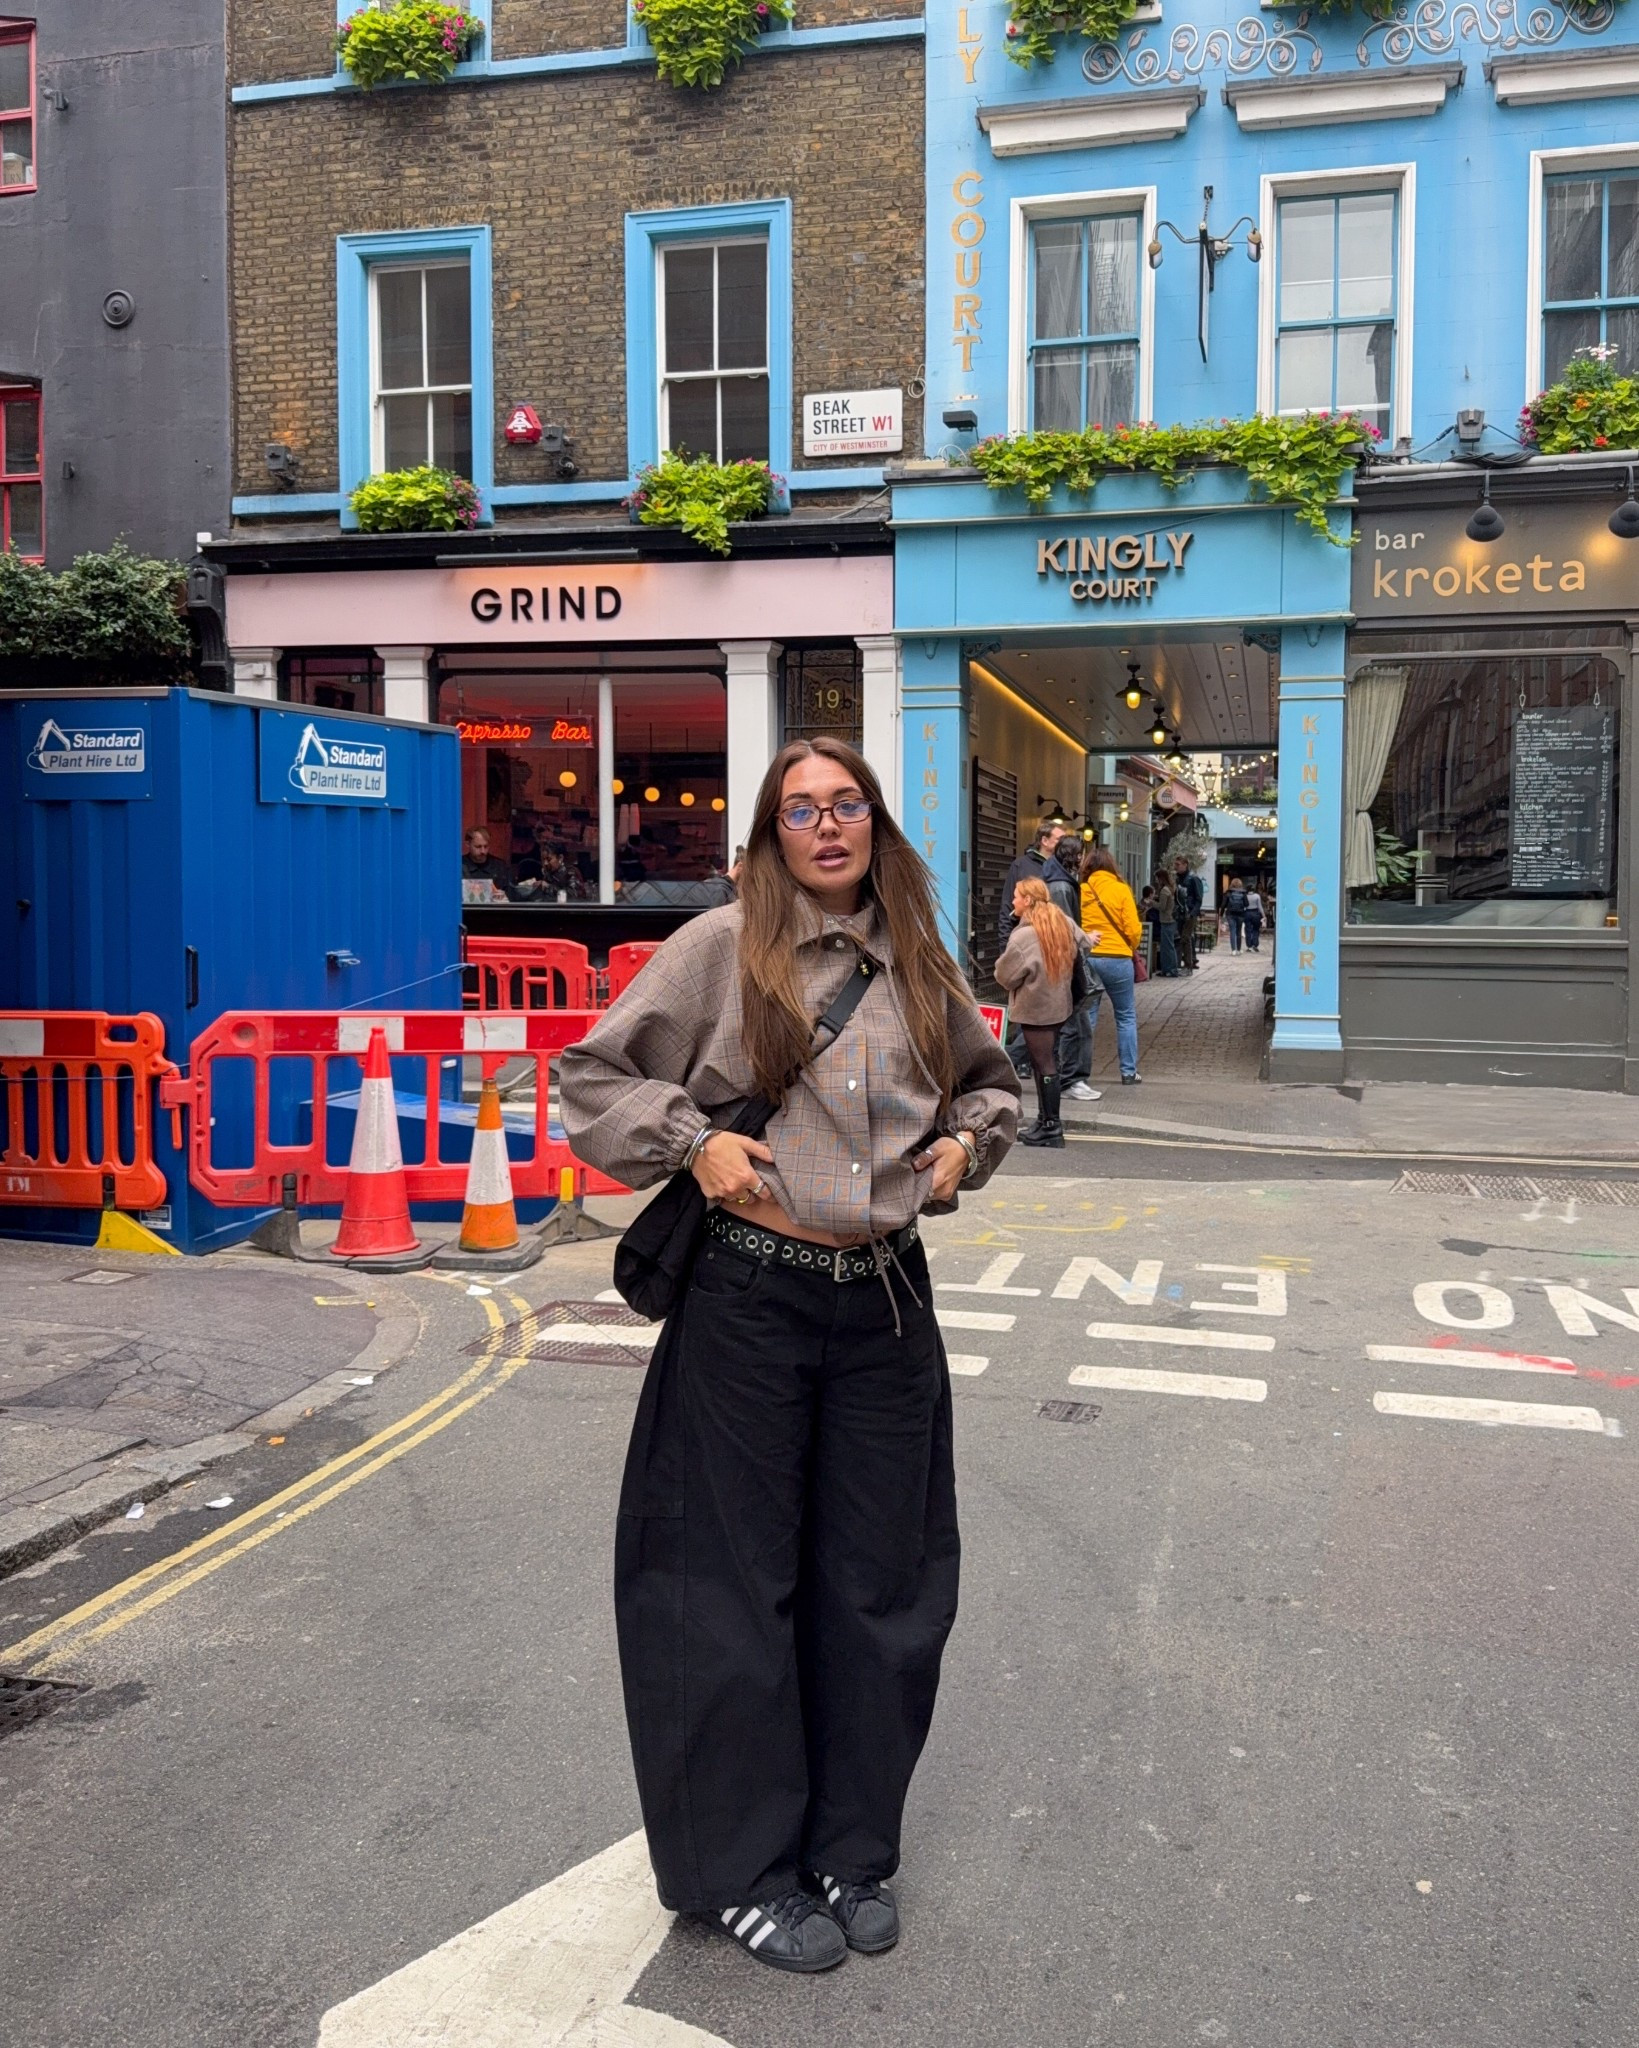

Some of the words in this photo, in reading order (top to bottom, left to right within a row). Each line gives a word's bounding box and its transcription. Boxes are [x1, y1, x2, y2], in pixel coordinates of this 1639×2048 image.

[958, 0, 984, 84] LY
[951, 170, 986, 373] COURT
[813, 399, 850, 416] BEAK
[813, 417, 866, 435] STREET
[872, 415, 892, 431] W1
[813, 444, 828, 452] CITY
[830, 443, 838, 451] OF
[840, 440, 888, 451] WESTMINSTER
[1375, 529, 1425, 551] bar
[1037, 532, 1193, 575] KINGLY
[1373, 554, 1586, 598] kroketa
[1070, 577, 1158, 601] COURT
[471, 586, 622, 622] GRIND
[814, 689, 840, 709] 19
[73, 732, 140, 748] Standard
[456, 722, 531, 744] Espresso
[551, 720, 591, 740] Bar
[49, 754, 82, 768] Plant
[85, 754, 113, 768] Hire
[116, 754, 138, 767] Ltd
[330, 745, 384, 768] Standard
[309, 771, 338, 788] Plant
[341, 772, 362, 790] Hire
[364, 775, 382, 791] Ltd
[921, 721, 940, 859] KINGLY
[1299, 713, 1320, 859] KINGLY
[1297, 875, 1319, 996] COURT
[930, 1249, 1288, 1317] ENT
